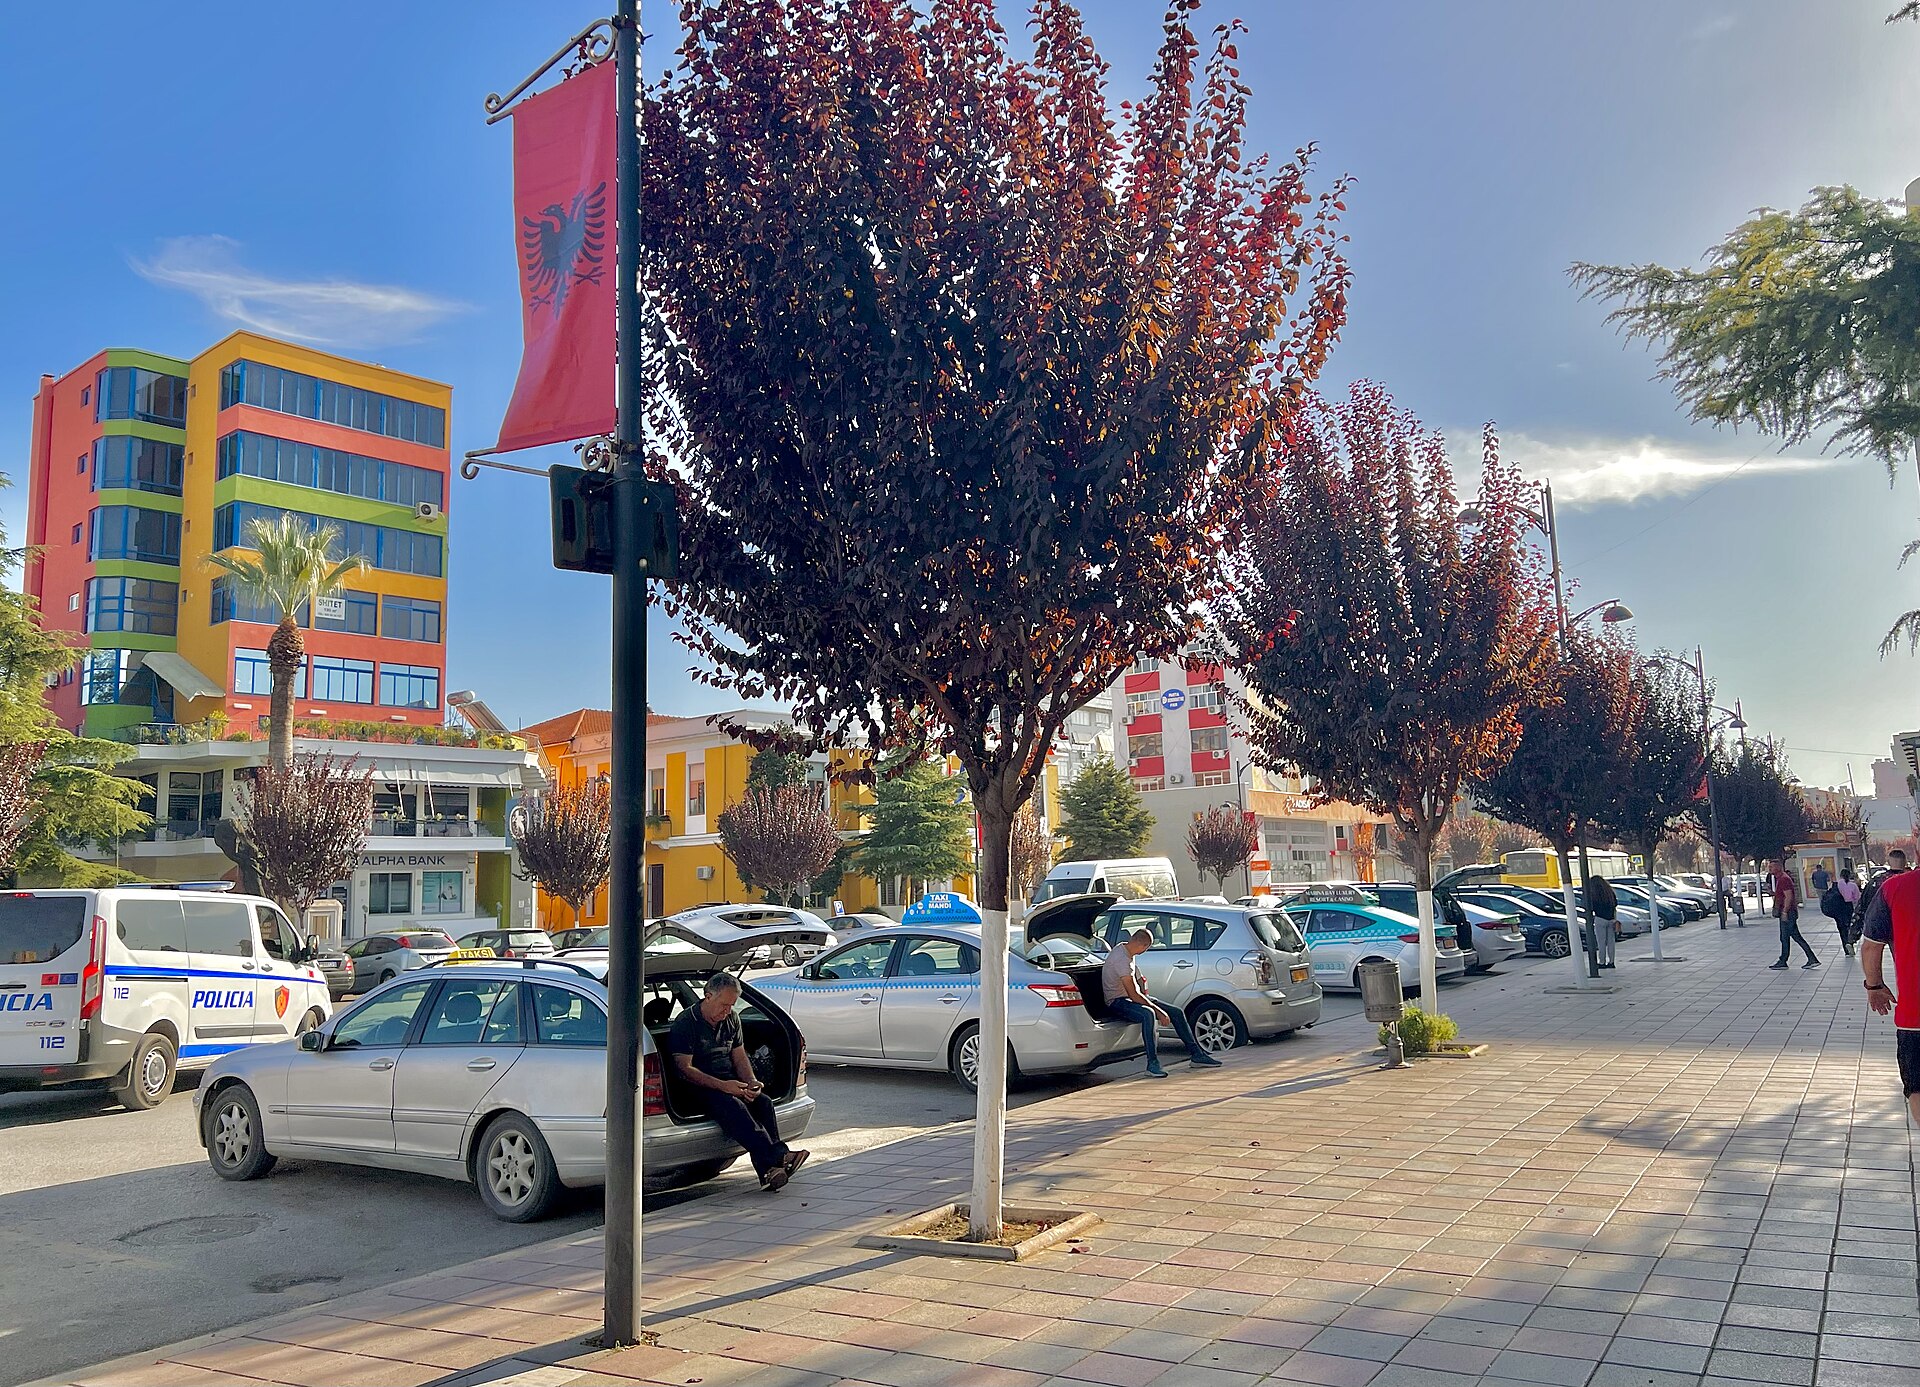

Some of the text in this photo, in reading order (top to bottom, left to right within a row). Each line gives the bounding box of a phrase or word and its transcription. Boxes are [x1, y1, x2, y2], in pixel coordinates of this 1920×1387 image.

[318, 599, 342, 608] SHITET
[361, 856, 446, 865] ALPHA BANK
[461, 949, 492, 959] TAKSI
[113, 987, 130, 1000] 112
[192, 990, 254, 1008] POLICIA
[40, 1036, 65, 1049] 112
